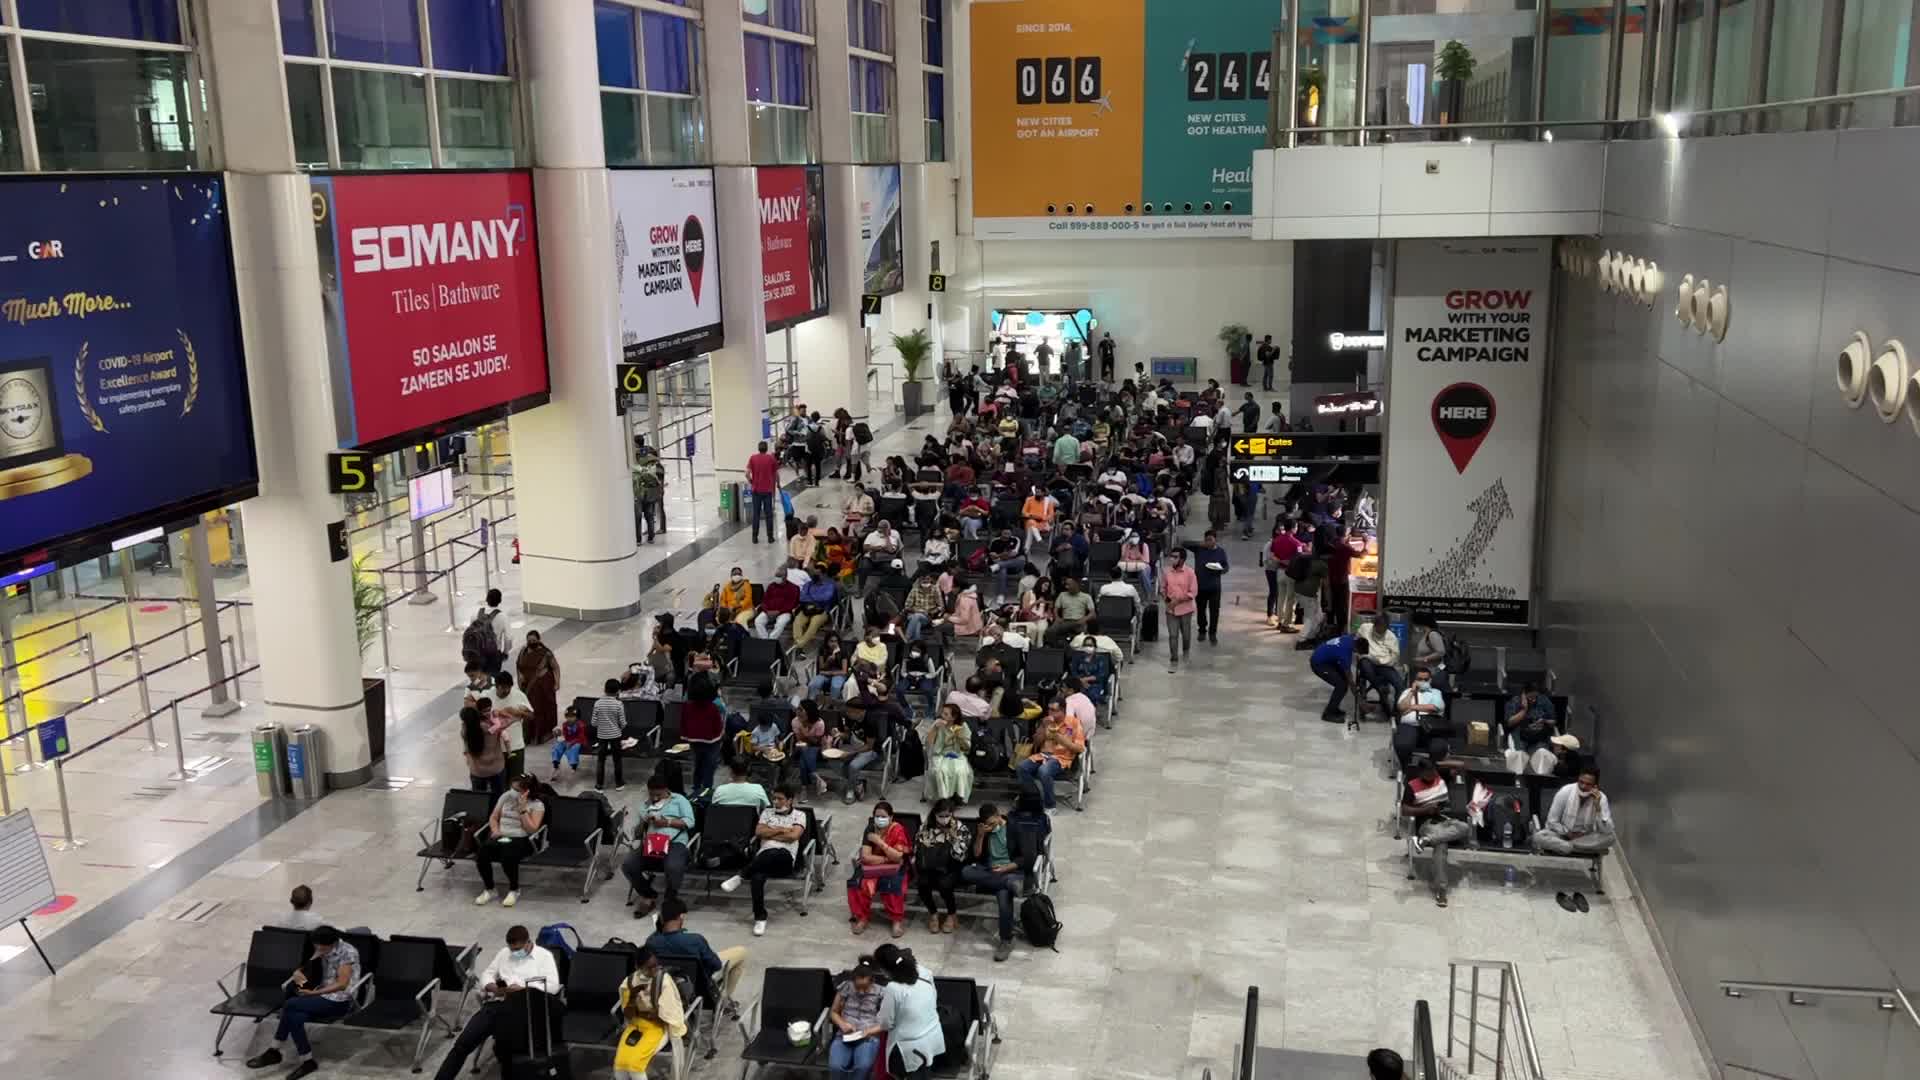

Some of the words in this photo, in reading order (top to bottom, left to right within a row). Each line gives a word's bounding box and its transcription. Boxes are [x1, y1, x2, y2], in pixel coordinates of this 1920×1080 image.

[1016, 23, 1045, 33] SINCE
[1016, 117, 1039, 127] NEW
[1041, 116, 1072, 126] CITIES
[1187, 114, 1212, 123] NEW
[1214, 113, 1247, 123] CITIES
[1016, 128, 1038, 138] GOT
[1040, 128, 1055, 138] AN
[1056, 128, 1100, 137] AIRPORT
[1187, 126, 1210, 135] GOT
[1049, 221, 1068, 230] Call
[1151, 222, 1165, 230] get
[649, 224, 679, 245] GROW
[351, 218, 520, 273] SOMANY
[651, 247, 666, 258] WITH
[667, 245, 680, 256] YOUR
[684, 239, 703, 253] HERE
[638, 259, 681, 280] MARKETING
[643, 277, 682, 297] CAMPAIGN
[932, 277, 943, 289] 8
[391, 288, 430, 315] Tiles
[438, 281, 501, 307] Bathware
[866, 296, 878, 314] 7
[1445, 290, 1531, 309] GROW
[1, 297, 61, 326] Much
[1448, 312, 1486, 324] WITH
[1490, 312, 1530, 323] YOUR
[1405, 327, 1530, 343] MARKETING
[412, 347, 430, 367] 50
[432, 337, 482, 363] SAALON
[483, 334, 497, 352] SE
[1416, 346, 1529, 362] CAMPAIGN
[98, 354, 141, 371] COVID-19
[142, 349, 175, 364] Airport
[99, 373, 149, 390] Excellence
[150, 366, 177, 381] Award
[401, 367, 453, 395] ZAMEEN
[455, 363, 471, 382] SE
[471, 354, 511, 378] JUDEY.
[623, 366, 642, 392] 6
[1439, 406, 1488, 420] HERE
[1267, 437, 1293, 447] Gates
[340, 456, 366, 490] 5
[1281, 465, 1309, 475] Toilets
